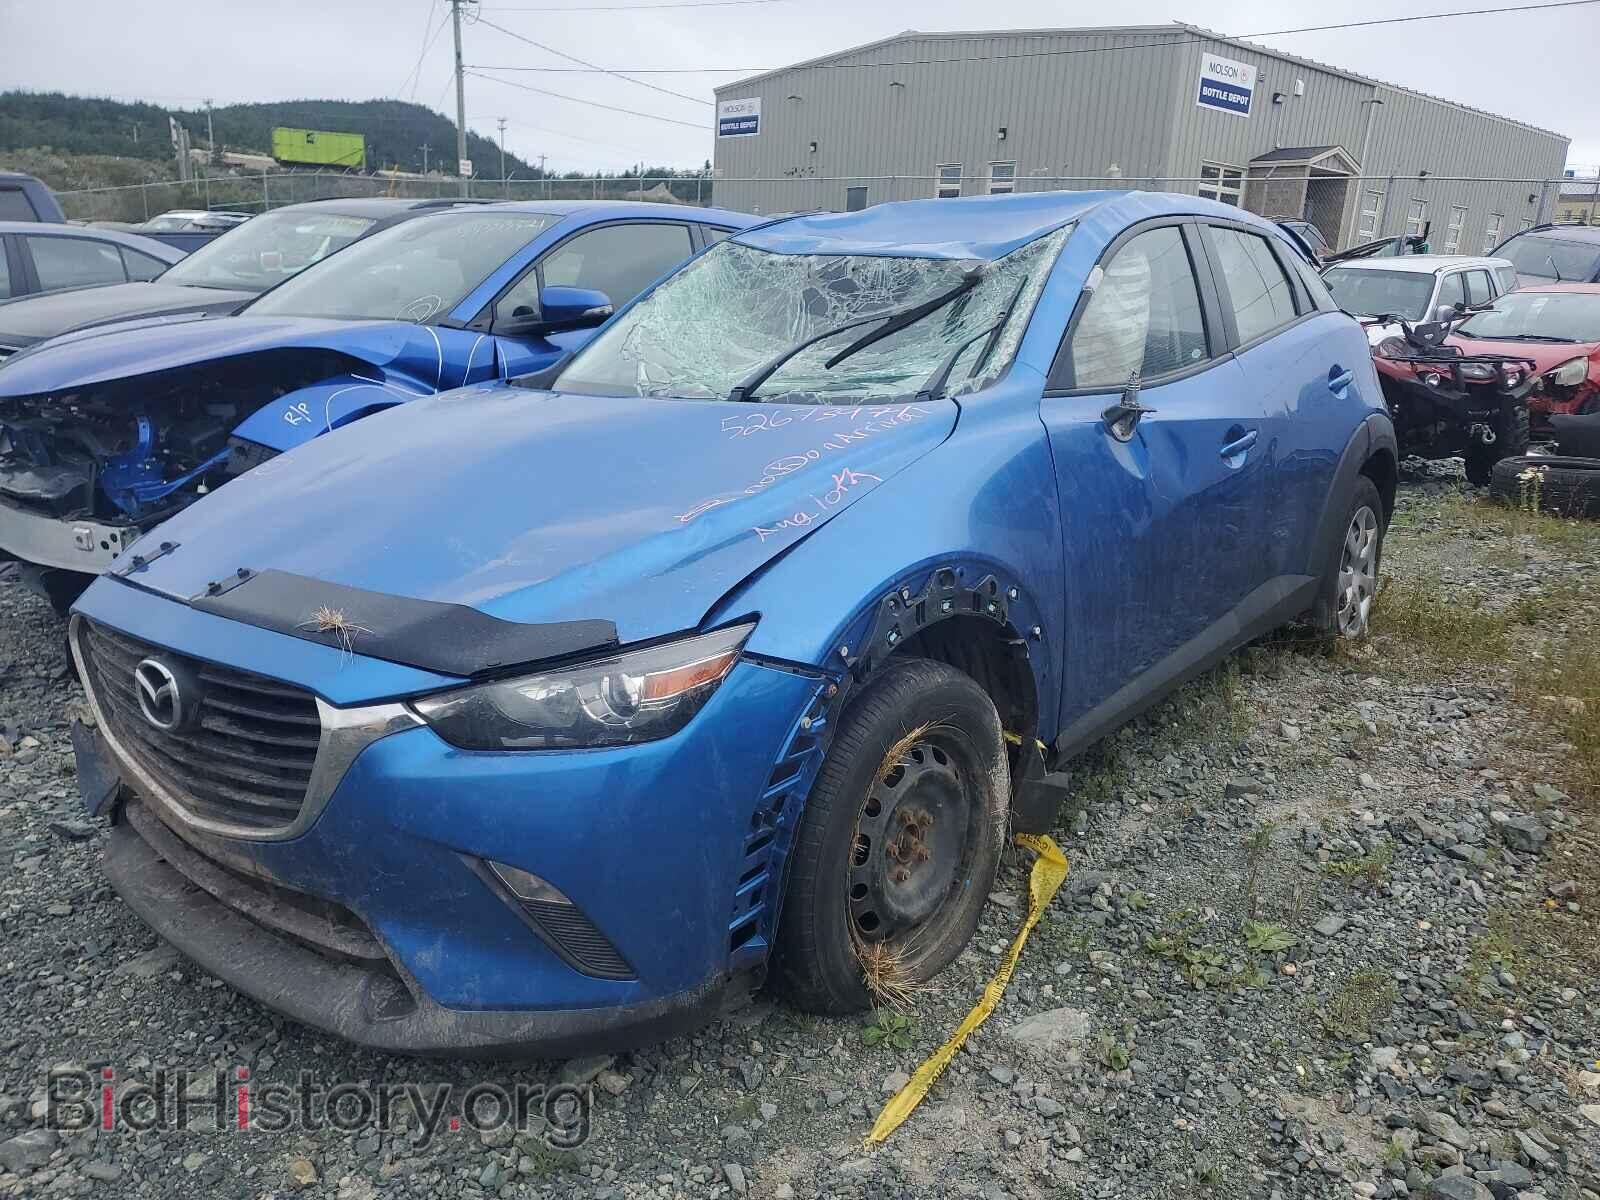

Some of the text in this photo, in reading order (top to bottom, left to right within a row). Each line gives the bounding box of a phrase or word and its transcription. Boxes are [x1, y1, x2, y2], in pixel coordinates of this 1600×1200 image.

[1209, 61, 1239, 78] MOLSON
[1202, 86, 1249, 106] BOTTLE DEPOT
